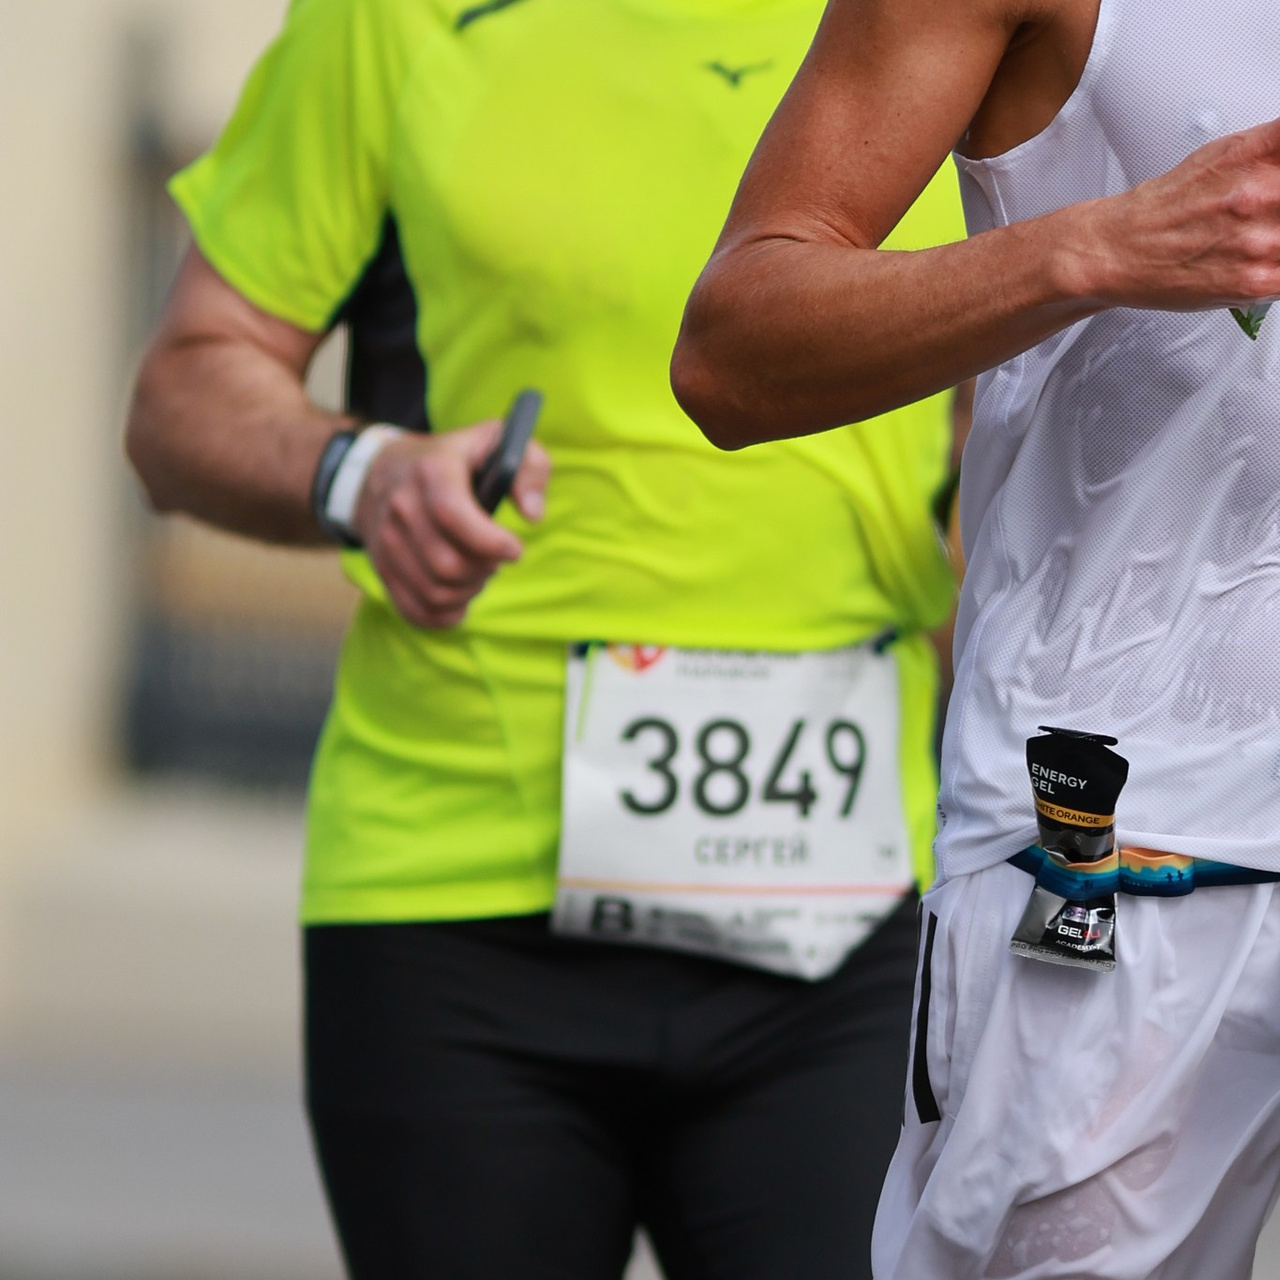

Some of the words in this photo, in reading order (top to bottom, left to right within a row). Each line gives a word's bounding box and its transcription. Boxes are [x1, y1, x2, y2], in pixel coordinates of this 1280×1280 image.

[619, 716, 867, 818] 3849
[1031, 762, 1087, 790] ENERGY
[1031, 776, 1055, 795] GEL
[1056, 809, 1100, 825] ORANGE
[694, 833, 808, 866] СЕРГЕЙ
[1055, 939, 1102, 952] ACADEMY-T
